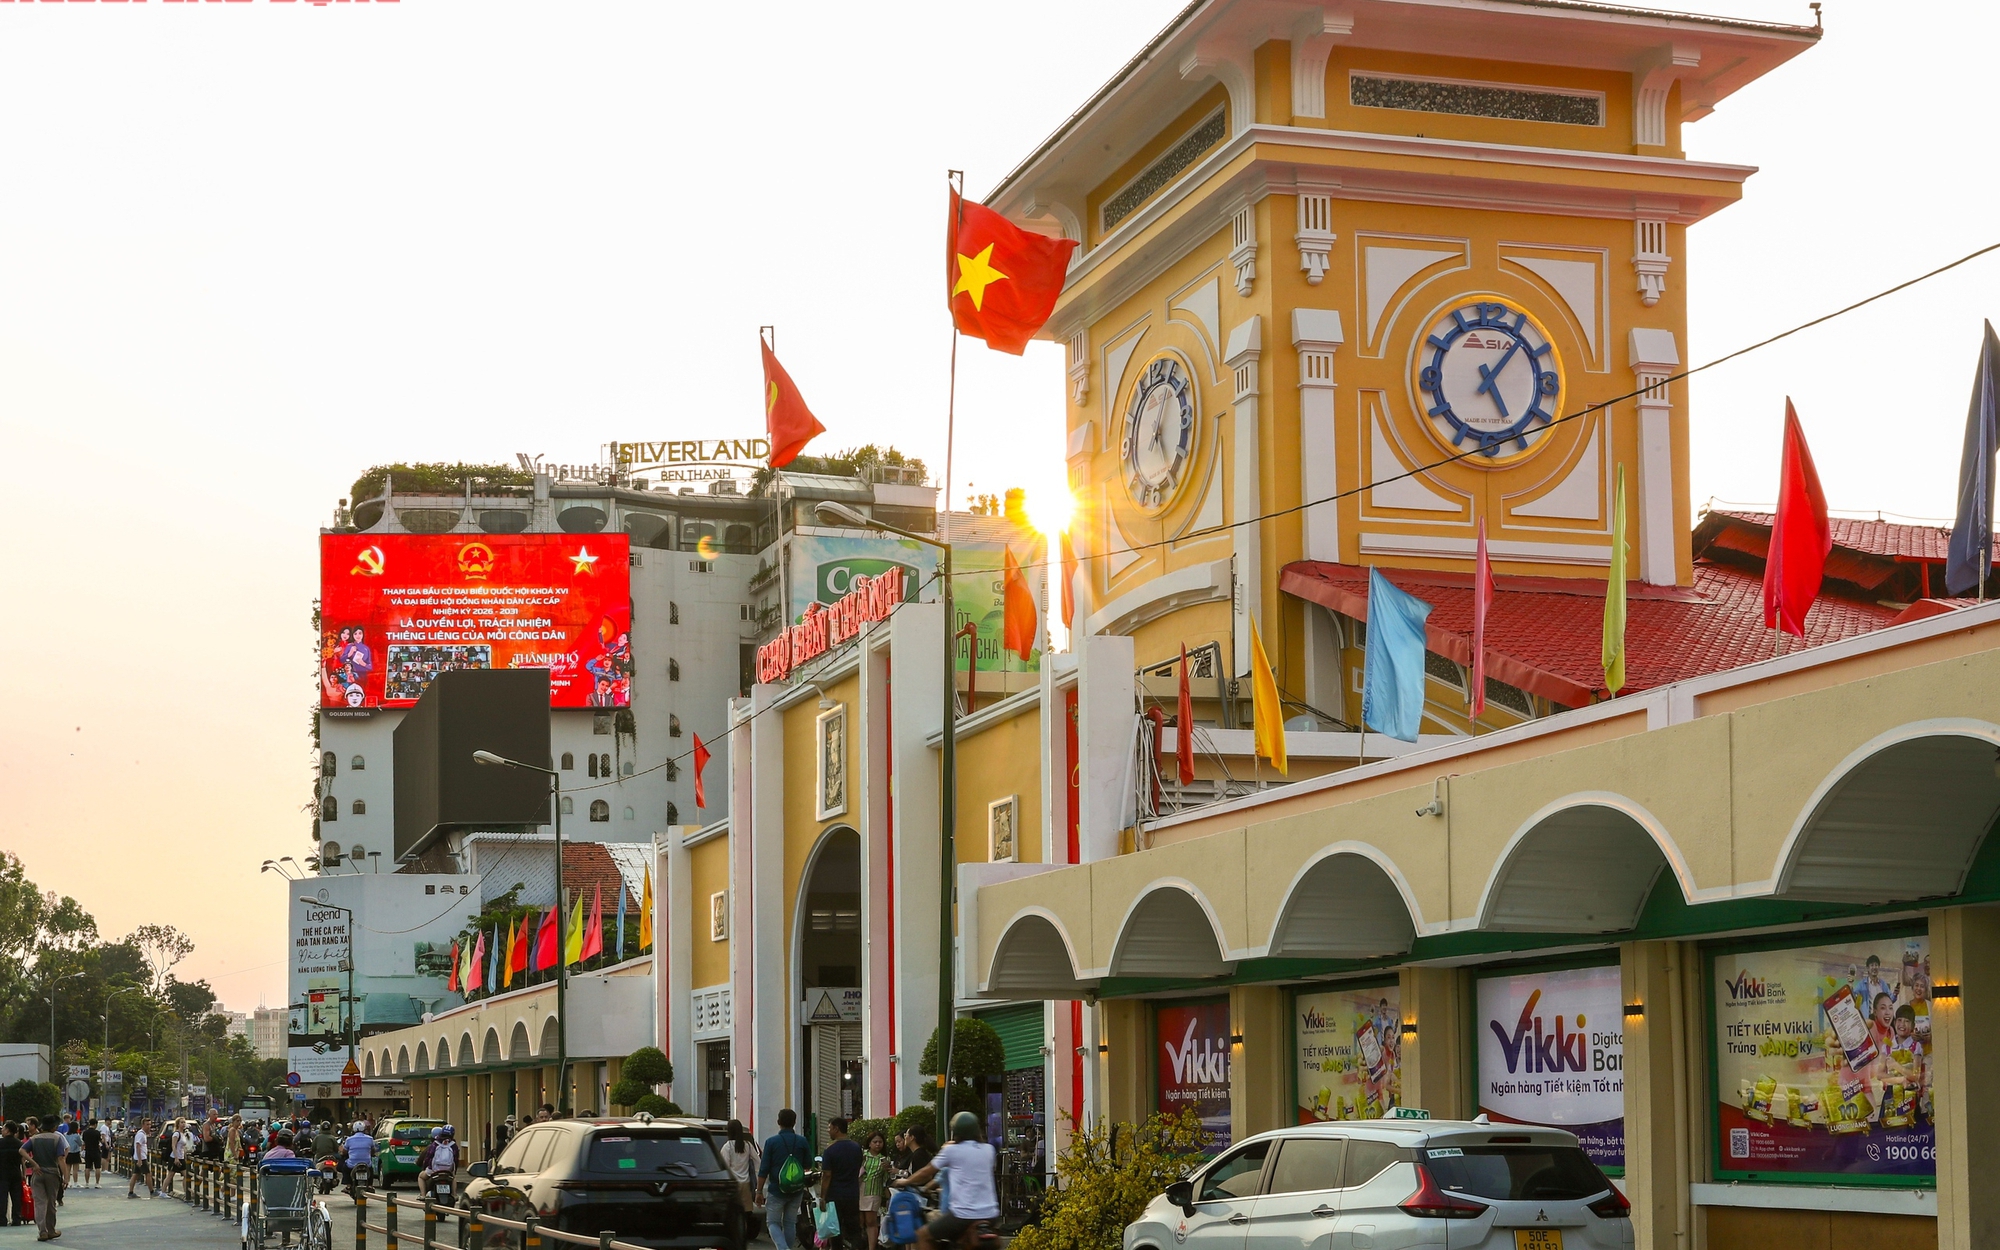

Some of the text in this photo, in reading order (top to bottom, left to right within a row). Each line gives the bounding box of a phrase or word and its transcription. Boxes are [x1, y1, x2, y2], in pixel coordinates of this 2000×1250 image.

[1476, 302, 1507, 327] 12
[1149, 358, 1163, 386] 12
[1419, 366, 1443, 391] 9
[1540, 371, 1560, 396] 3
[1180, 404, 1192, 430] 3
[619, 439, 771, 463] SILVERLAND
[1121, 437, 1131, 460] 9
[1480, 432, 1501, 457] 6
[1150, 484, 1162, 507] 6
[391, 597, 403, 605] VÀ
[400, 618, 414, 628] LÀ
[416, 618, 454, 628] QUYỀN
[478, 618, 514, 628] TRÁCH
[517, 618, 551, 629] NHIỆM
[386, 629, 566, 640] THIÊNG LIÊNG CỦA MỖI CÔNG DÂN
[307, 909, 341, 923] Legend
[1725, 968, 1766, 999] Vikki
[1767, 988, 1786, 997] Bank
[1302, 1006, 1325, 1029] Vikki
[1490, 988, 1587, 1075] Vikki
[1726, 1019, 1812, 1039] TIẾT KIỆM Vikki
[1165, 1017, 1225, 1085] Vikki
[1303, 1044, 1351, 1059] TIẾT KIỆM Vikki
[1727, 1037, 1813, 1058] Trúng VÀNG ký
[1303, 1060, 1320, 1071] Trúng
[1165, 1086, 1226, 1101] Ngân hàng Tiết kiệm
[1491, 1081, 1516, 1096] Ngân
[1518, 1080, 1542, 1096] hàng
[1544, 1077, 1565, 1093] Tiết
[1566, 1079, 1591, 1096] kiệm
[1593, 1076, 1610, 1092] Tốt
[1397, 1109, 1428, 1120] TAXI
[1885, 1134, 1929, 1143] Hotline (24/7)
[1603, 1149, 1617, 1158] your
[1885, 1146, 1918, 1160] 1900
[1528, 1231, 1549, 1242] 50E
